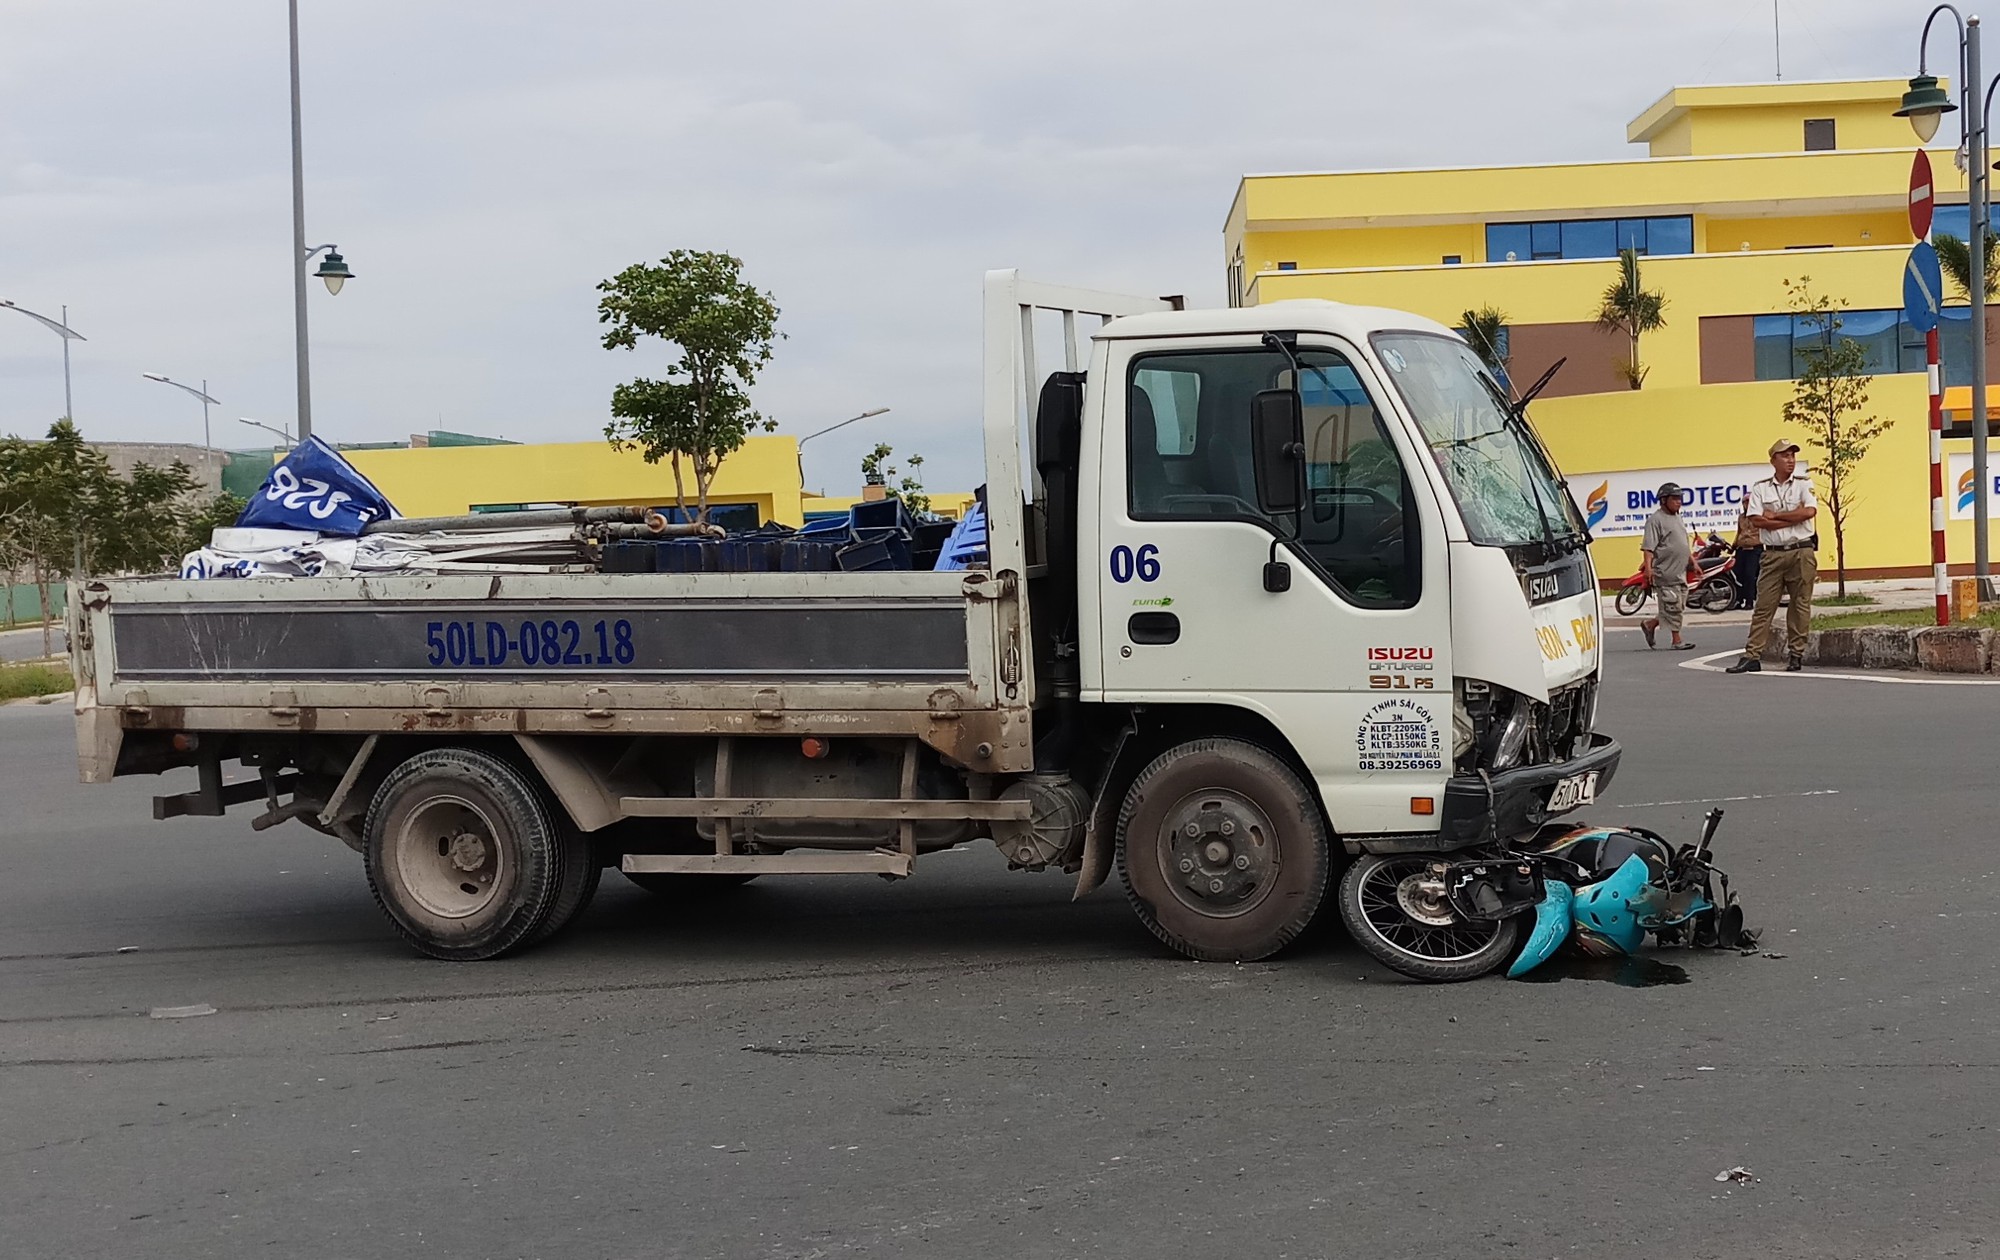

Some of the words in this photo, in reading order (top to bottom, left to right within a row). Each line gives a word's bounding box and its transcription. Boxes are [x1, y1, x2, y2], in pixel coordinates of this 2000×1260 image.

[1109, 543, 1161, 583] 06
[1529, 574, 1559, 600] ISUZU
[426, 619, 635, 666] 50LD-082.18
[1368, 647, 1433, 660] ISUZU
[1369, 675, 1410, 689] 91
[1414, 677, 1434, 689] PS
[1362, 712, 1373, 724] TY
[1372, 699, 1397, 714] TNHH
[1431, 730, 1440, 750] RDC
[1370, 724, 1427, 733] KLBT:2205KG
[1371, 741, 1427, 749] KLTB:3550KG
[1359, 760, 1442, 770] 08.39256969
